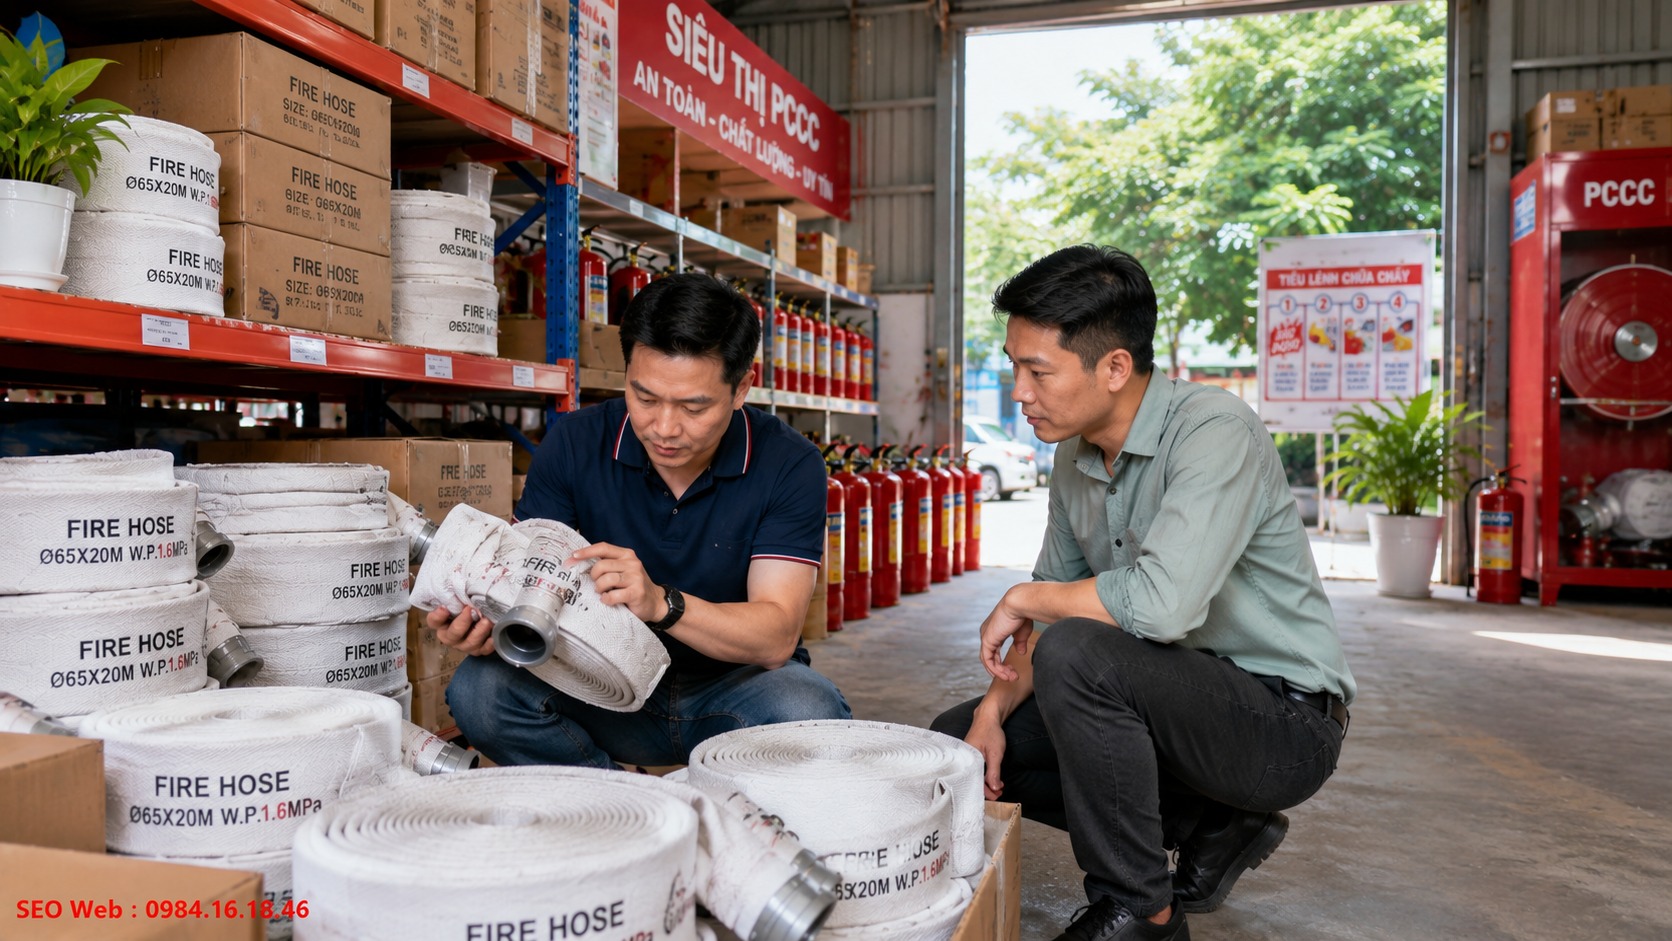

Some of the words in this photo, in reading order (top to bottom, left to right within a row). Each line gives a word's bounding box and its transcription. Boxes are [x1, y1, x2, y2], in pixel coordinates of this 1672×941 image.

[665, 2, 725, 85] SIÊU
[730, 51, 767, 127] THỊ
[771, 82, 820, 152] PCCC
[283, 97, 309, 117] SIZE:
[290, 76, 318, 102] FIRE
[323, 91, 356, 118] HOSE
[633, 60, 659, 98] AN
[663, 76, 706, 127] TOÀN
[718, 114, 754, 155] CHẤT
[756, 136, 795, 179] LƯỢNG
[803, 165, 817, 192] UY
[149, 156, 186, 178] FIRE
[190, 165, 215, 190] HOSE
[292, 166, 320, 190] FIRE
[325, 177, 357, 200] HOSE
[126, 176, 187, 198] Ø65X20M
[1584, 178, 1656, 208] PCCC
[169, 249, 200, 269] FIRE
[204, 256, 222, 276] HOSE
[293, 256, 322, 277] FIRE
[327, 263, 360, 285] HOSE
[147, 268, 203, 289] Ø65X20M
[285, 279, 313, 296] SIZE:
[463, 304, 485, 319] FIRE
[1284, 299, 1291, 311] 1
[1319, 298, 1328, 310] 2
[1355, 296, 1365, 309] 3
[1393, 295, 1402, 308] 4
[67, 518, 121, 539] FIRE
[128, 515, 175, 537] HOSE
[40, 546, 123, 565] Ø65X20M
[129, 540, 188, 562] W.P.1.6MPa
[351, 562, 380, 579] FIRE
[384, 558, 406, 576] HOSE
[332, 582, 383, 600] Ø65X20M
[79, 636, 132, 660] FIRE
[138, 626, 185, 653] HOSE
[345, 643, 376, 661] FIRE
[379, 636, 402, 656] HOSE
[50, 664, 134, 689] Ø65X20M
[140, 650, 199, 678] W.P.1.6MPa
[326, 664, 378, 684] Ø65X20M
[155, 775, 210, 798] FIRE
[219, 770, 290, 797] HOSE
[130, 804, 213, 827] Ø65X20M
[221, 798, 322, 825] W.P.1.6MPa
[467, 919, 537, 941] FIRE
[549, 900, 624, 941] HOSE
